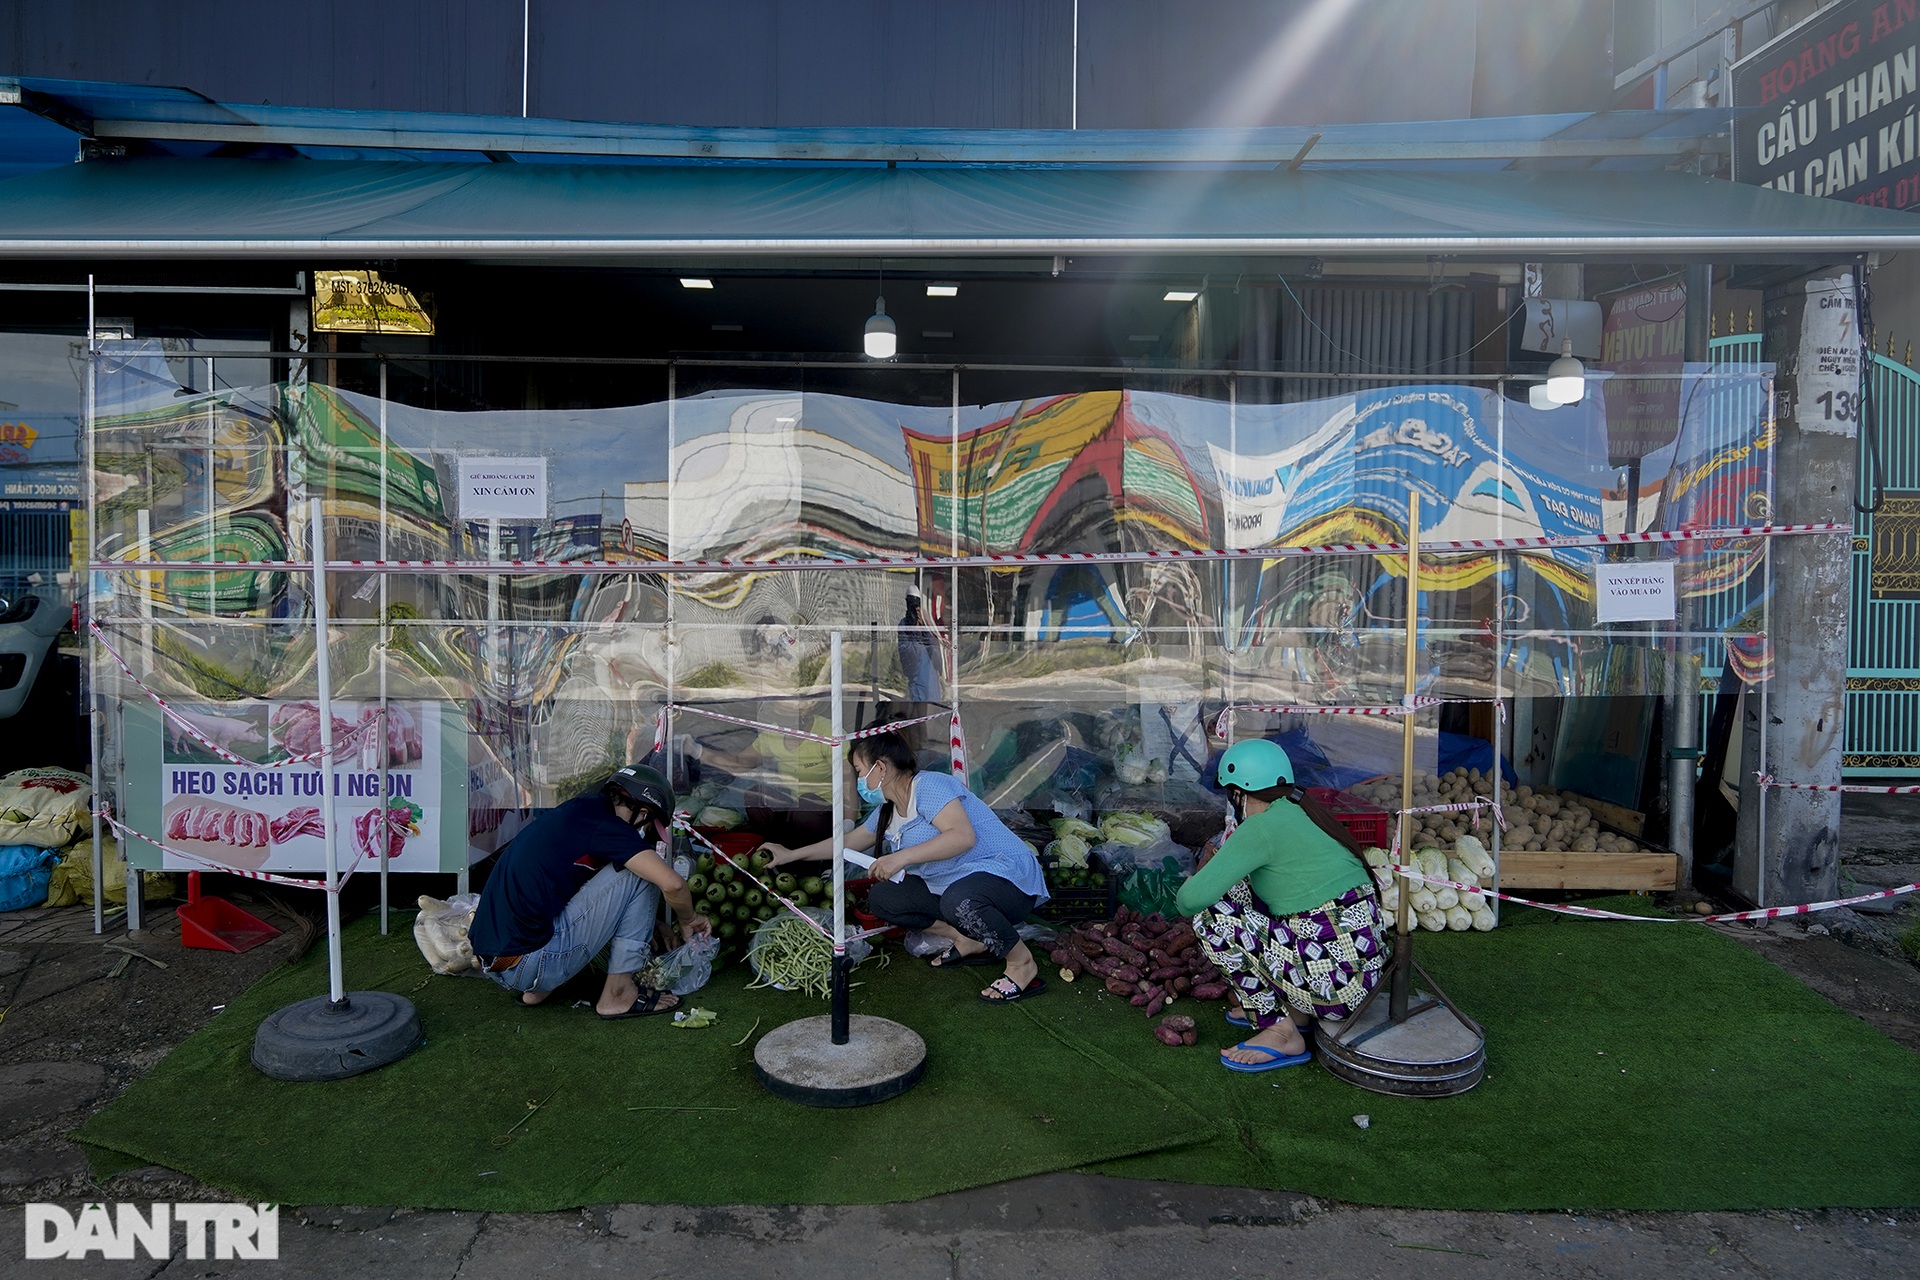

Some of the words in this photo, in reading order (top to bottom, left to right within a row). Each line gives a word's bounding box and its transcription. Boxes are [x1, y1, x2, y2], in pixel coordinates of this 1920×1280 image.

[1760, 20, 1862, 105] HOÀNG
[1870, 0, 1920, 43] AN
[1758, 98, 1817, 166] CẦU
[1804, 137, 1868, 198] CAN
[1878, 104, 1920, 174] KÍ
[1820, 294, 1842, 309] CẤM
[473, 487, 491, 496] XIN
[520, 487, 536, 496] ƠN
[1608, 578, 1623, 586] XIN
[1624, 576, 1640, 585] XẾP
[1641, 575, 1665, 585] HÀNG
[1610, 587, 1628, 596] VÀO
[1629, 588, 1648, 596] MUA
[172, 771, 216, 795] HEO
[223, 771, 283, 800] SẠCH
[348, 773, 412, 797] NGON
